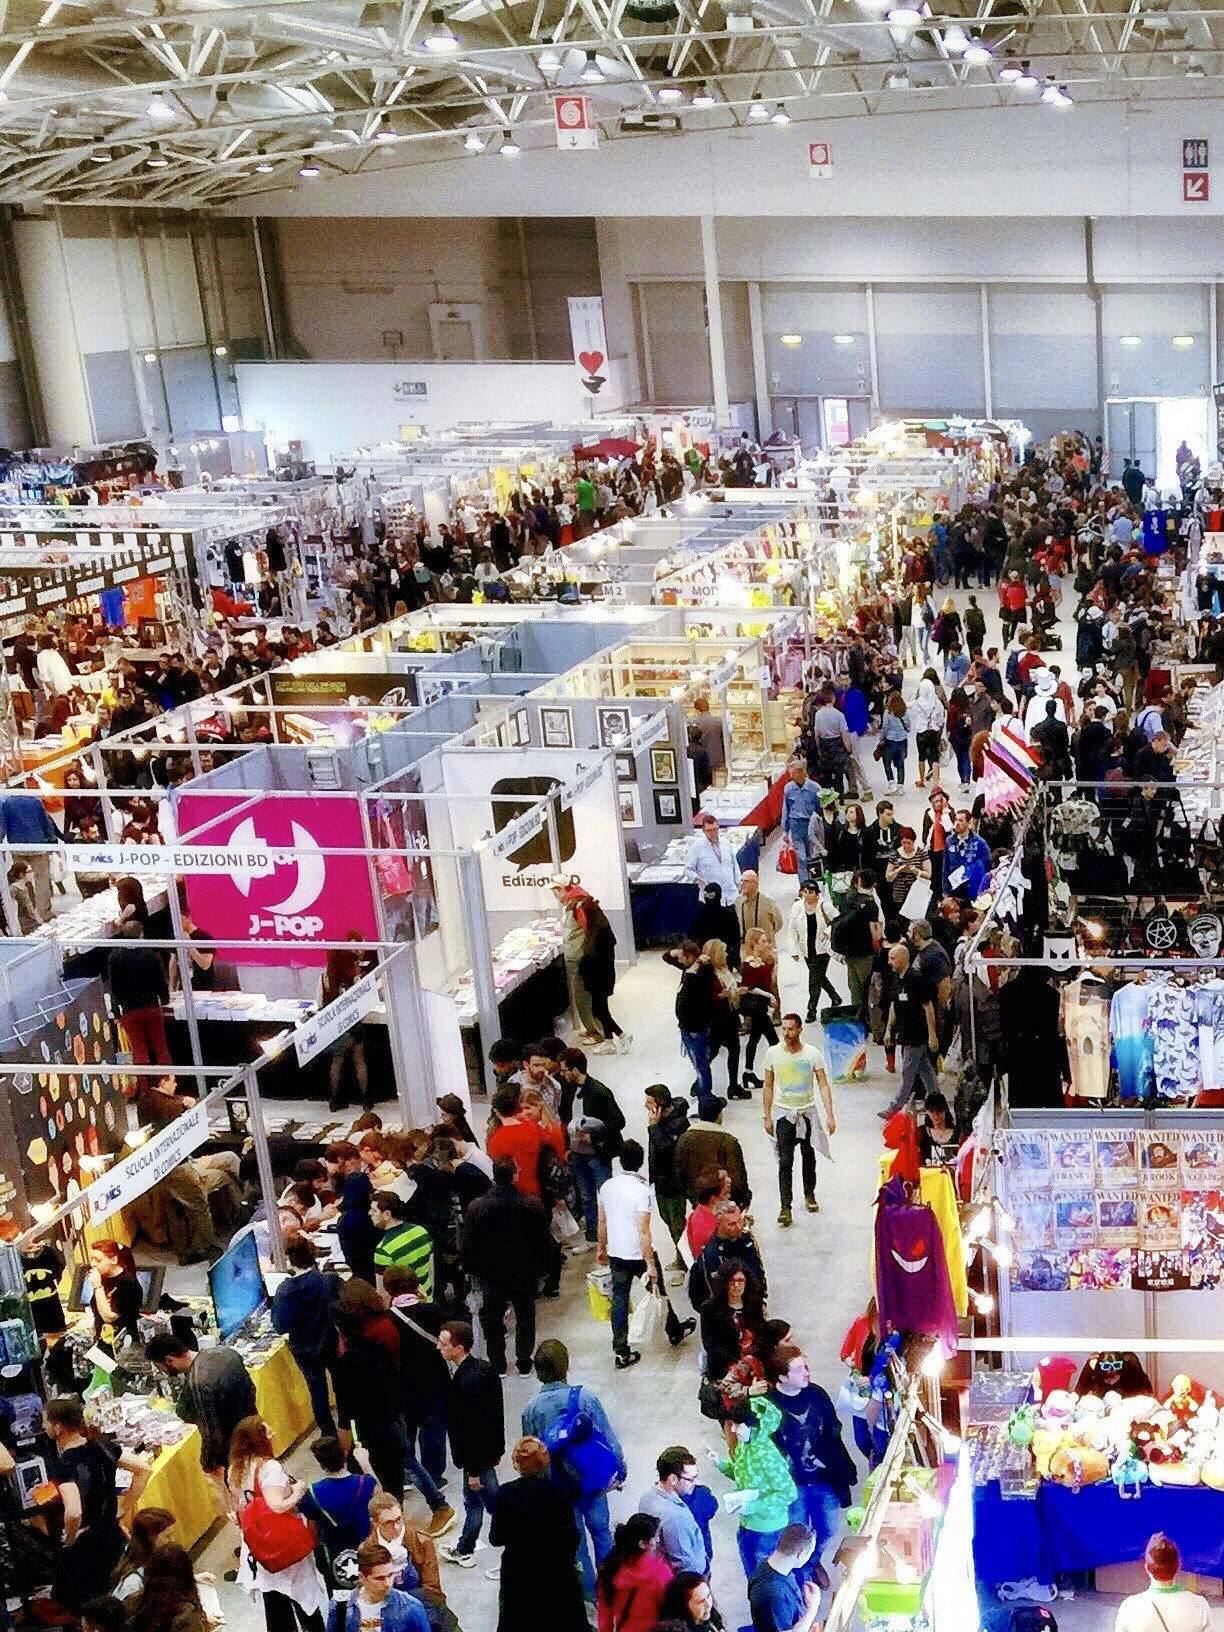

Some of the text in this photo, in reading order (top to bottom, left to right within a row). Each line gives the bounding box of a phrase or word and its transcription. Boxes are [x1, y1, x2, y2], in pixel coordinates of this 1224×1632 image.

[119, 852, 161, 866] J-POP
[173, 853, 243, 867] EDIZIONI
[247, 854, 268, 867] BD
[248, 914, 324, 937] J-POP
[1095, 1131, 1136, 1142] WANTED
[1139, 1132, 1180, 1143] WANTED
[1181, 1132, 1223, 1143] WANTED
[1143, 1173, 1176, 1181] BROOK
[1097, 1191, 1139, 1201] WANTED
[1140, 1191, 1180, 1201] WANTED
